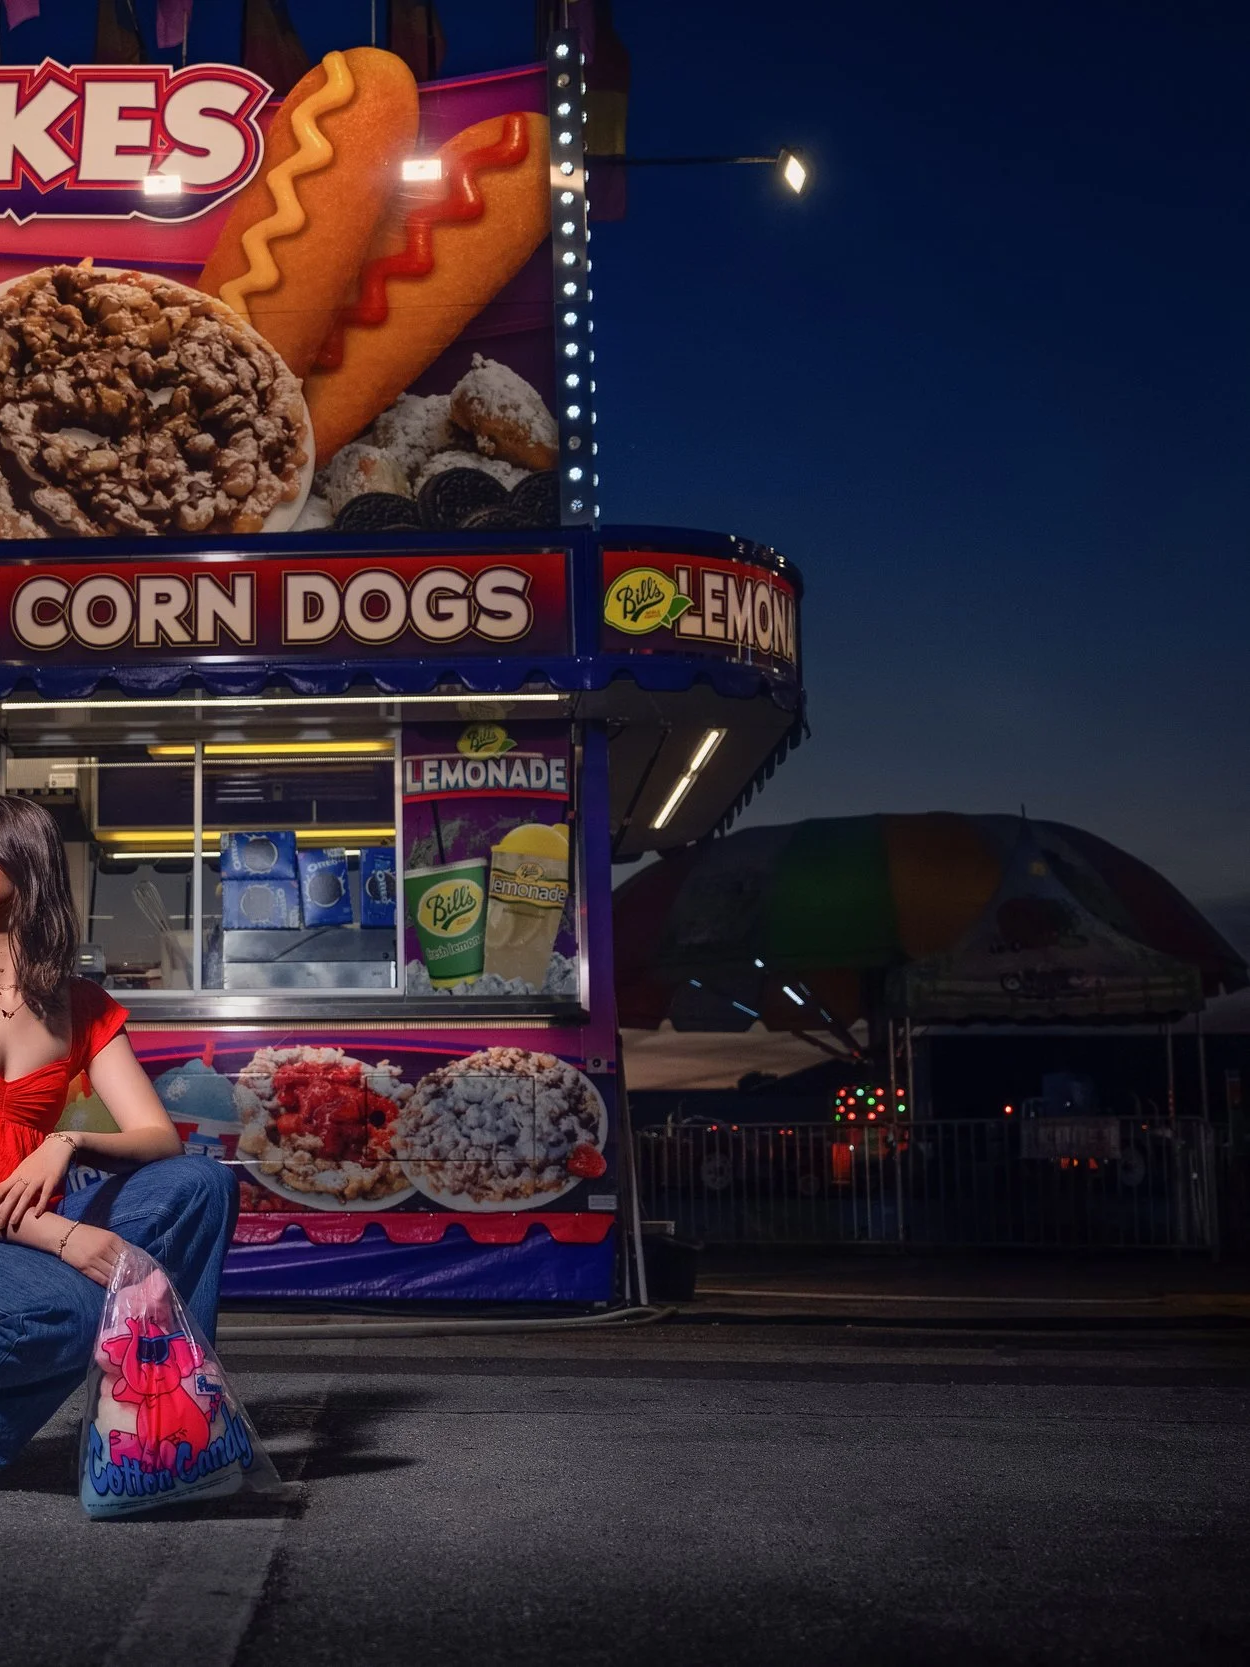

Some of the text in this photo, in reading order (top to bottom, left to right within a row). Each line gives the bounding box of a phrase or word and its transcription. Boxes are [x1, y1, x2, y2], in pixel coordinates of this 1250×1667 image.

[12, 566, 534, 649] CORN DOGS
[616, 576, 665, 622] Bill's
[405, 758, 568, 793] LEMONADE
[426, 885, 477, 931] Bill's
[491, 873, 567, 902] lemonade
[88, 1421, 176, 1497] Cotton
[175, 1400, 255, 1484] Candy
